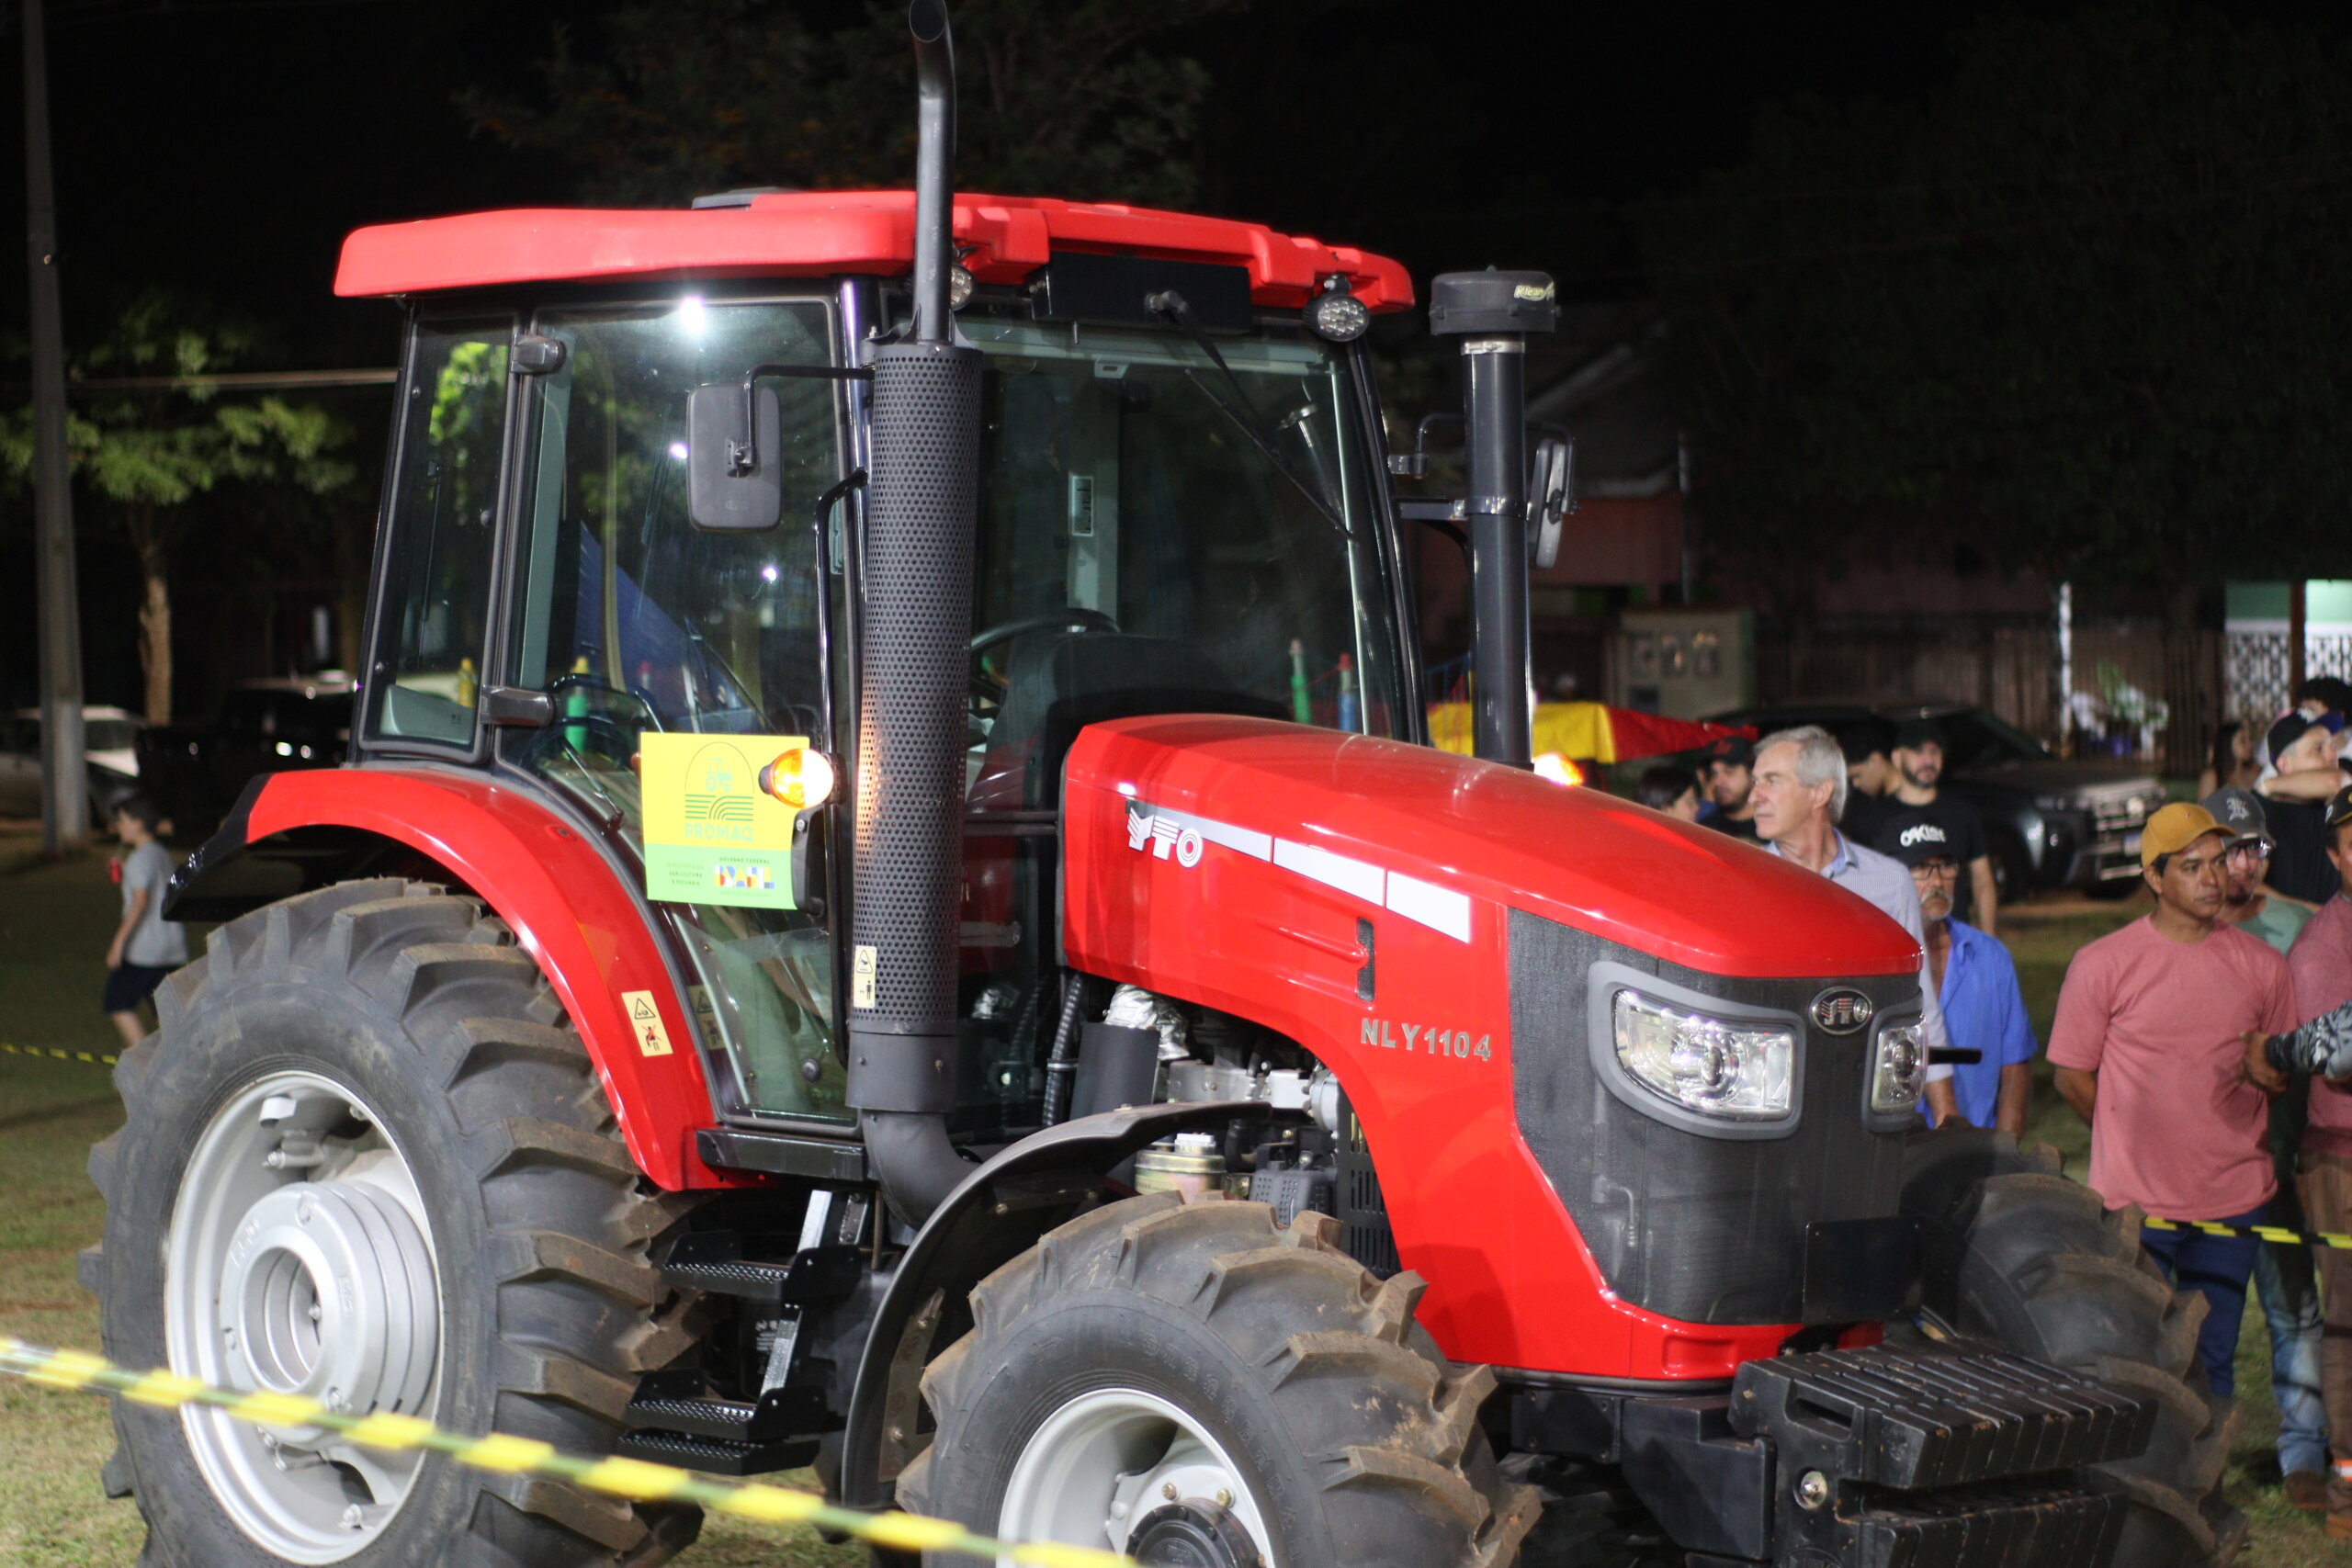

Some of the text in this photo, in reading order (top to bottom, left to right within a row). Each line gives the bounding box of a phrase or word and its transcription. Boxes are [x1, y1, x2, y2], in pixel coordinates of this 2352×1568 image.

[684, 822, 753, 842] PROMAQ
[1126, 807, 1204, 868] YTO
[713, 863, 775, 889] BRASIL
[1821, 998, 1869, 1026] YTO
[1360, 1017, 1492, 1062] NLY1104
